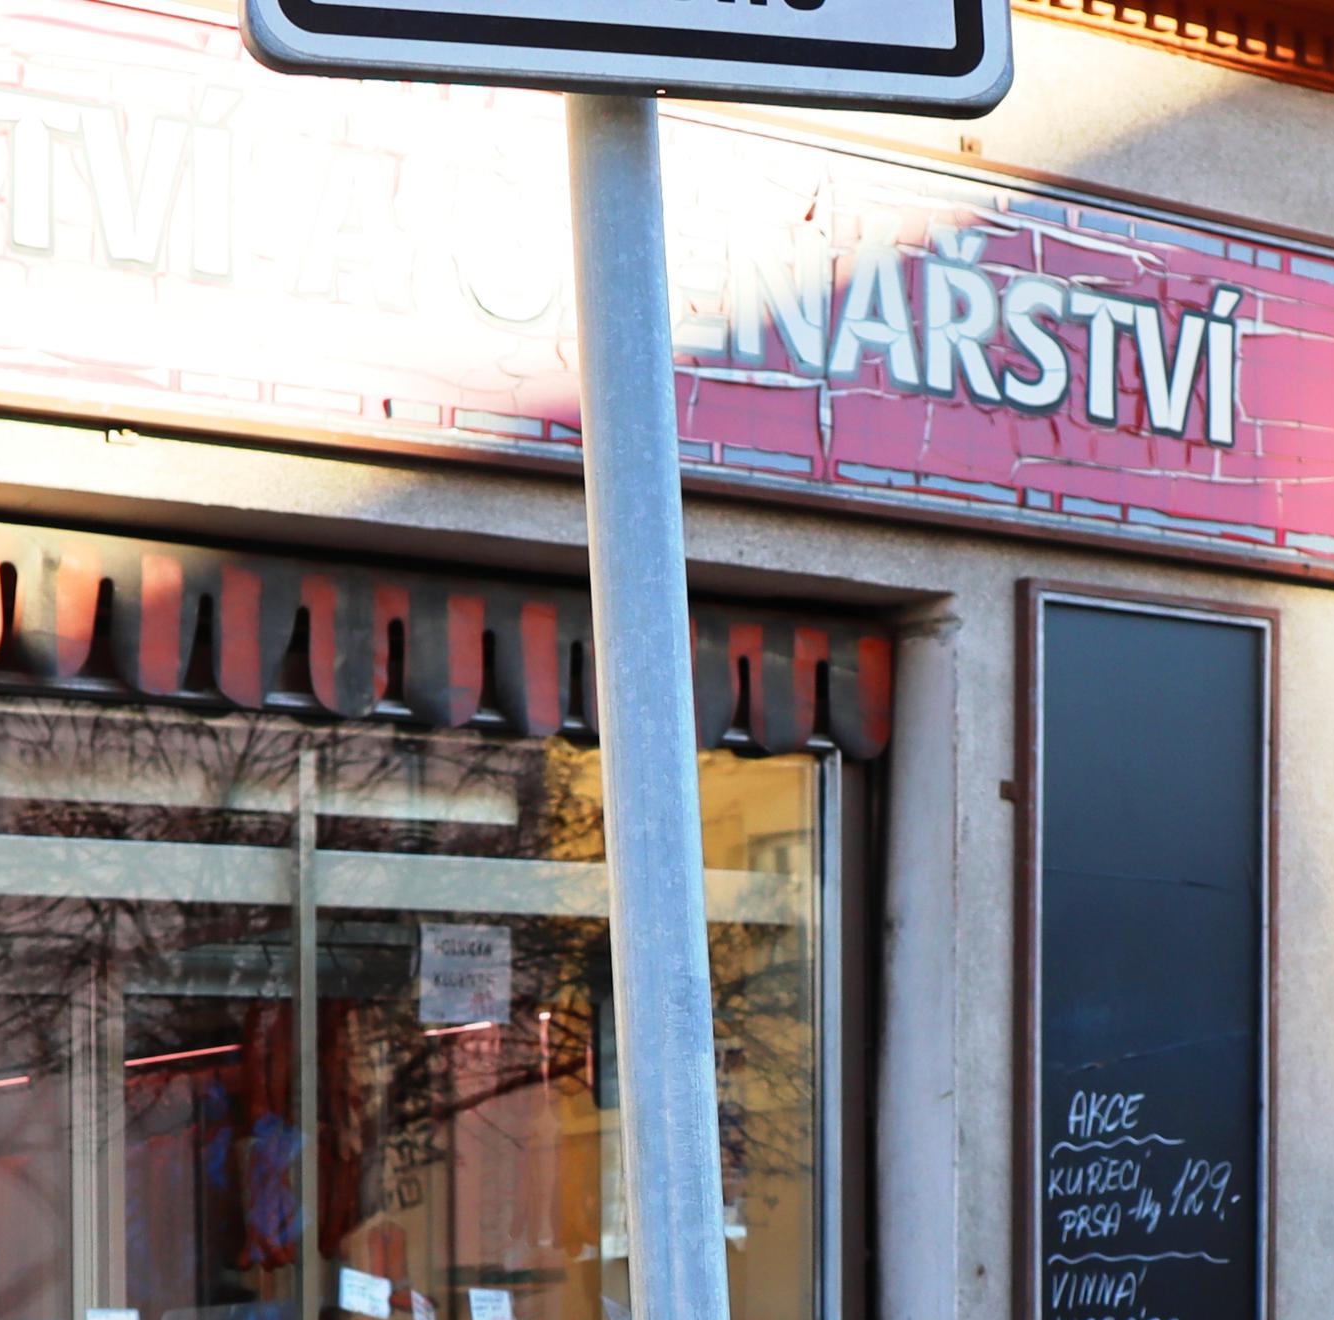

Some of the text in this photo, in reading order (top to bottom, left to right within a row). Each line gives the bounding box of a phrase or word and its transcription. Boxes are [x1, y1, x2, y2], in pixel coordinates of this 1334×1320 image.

[1068, 1090, 1145, 1138] AKCE
[1048, 1149, 1151, 1199] KUŘECÍ
[1058, 1202, 1122, 1243] PRSA
[1051, 1266, 1147, 1309] VINNÁ
